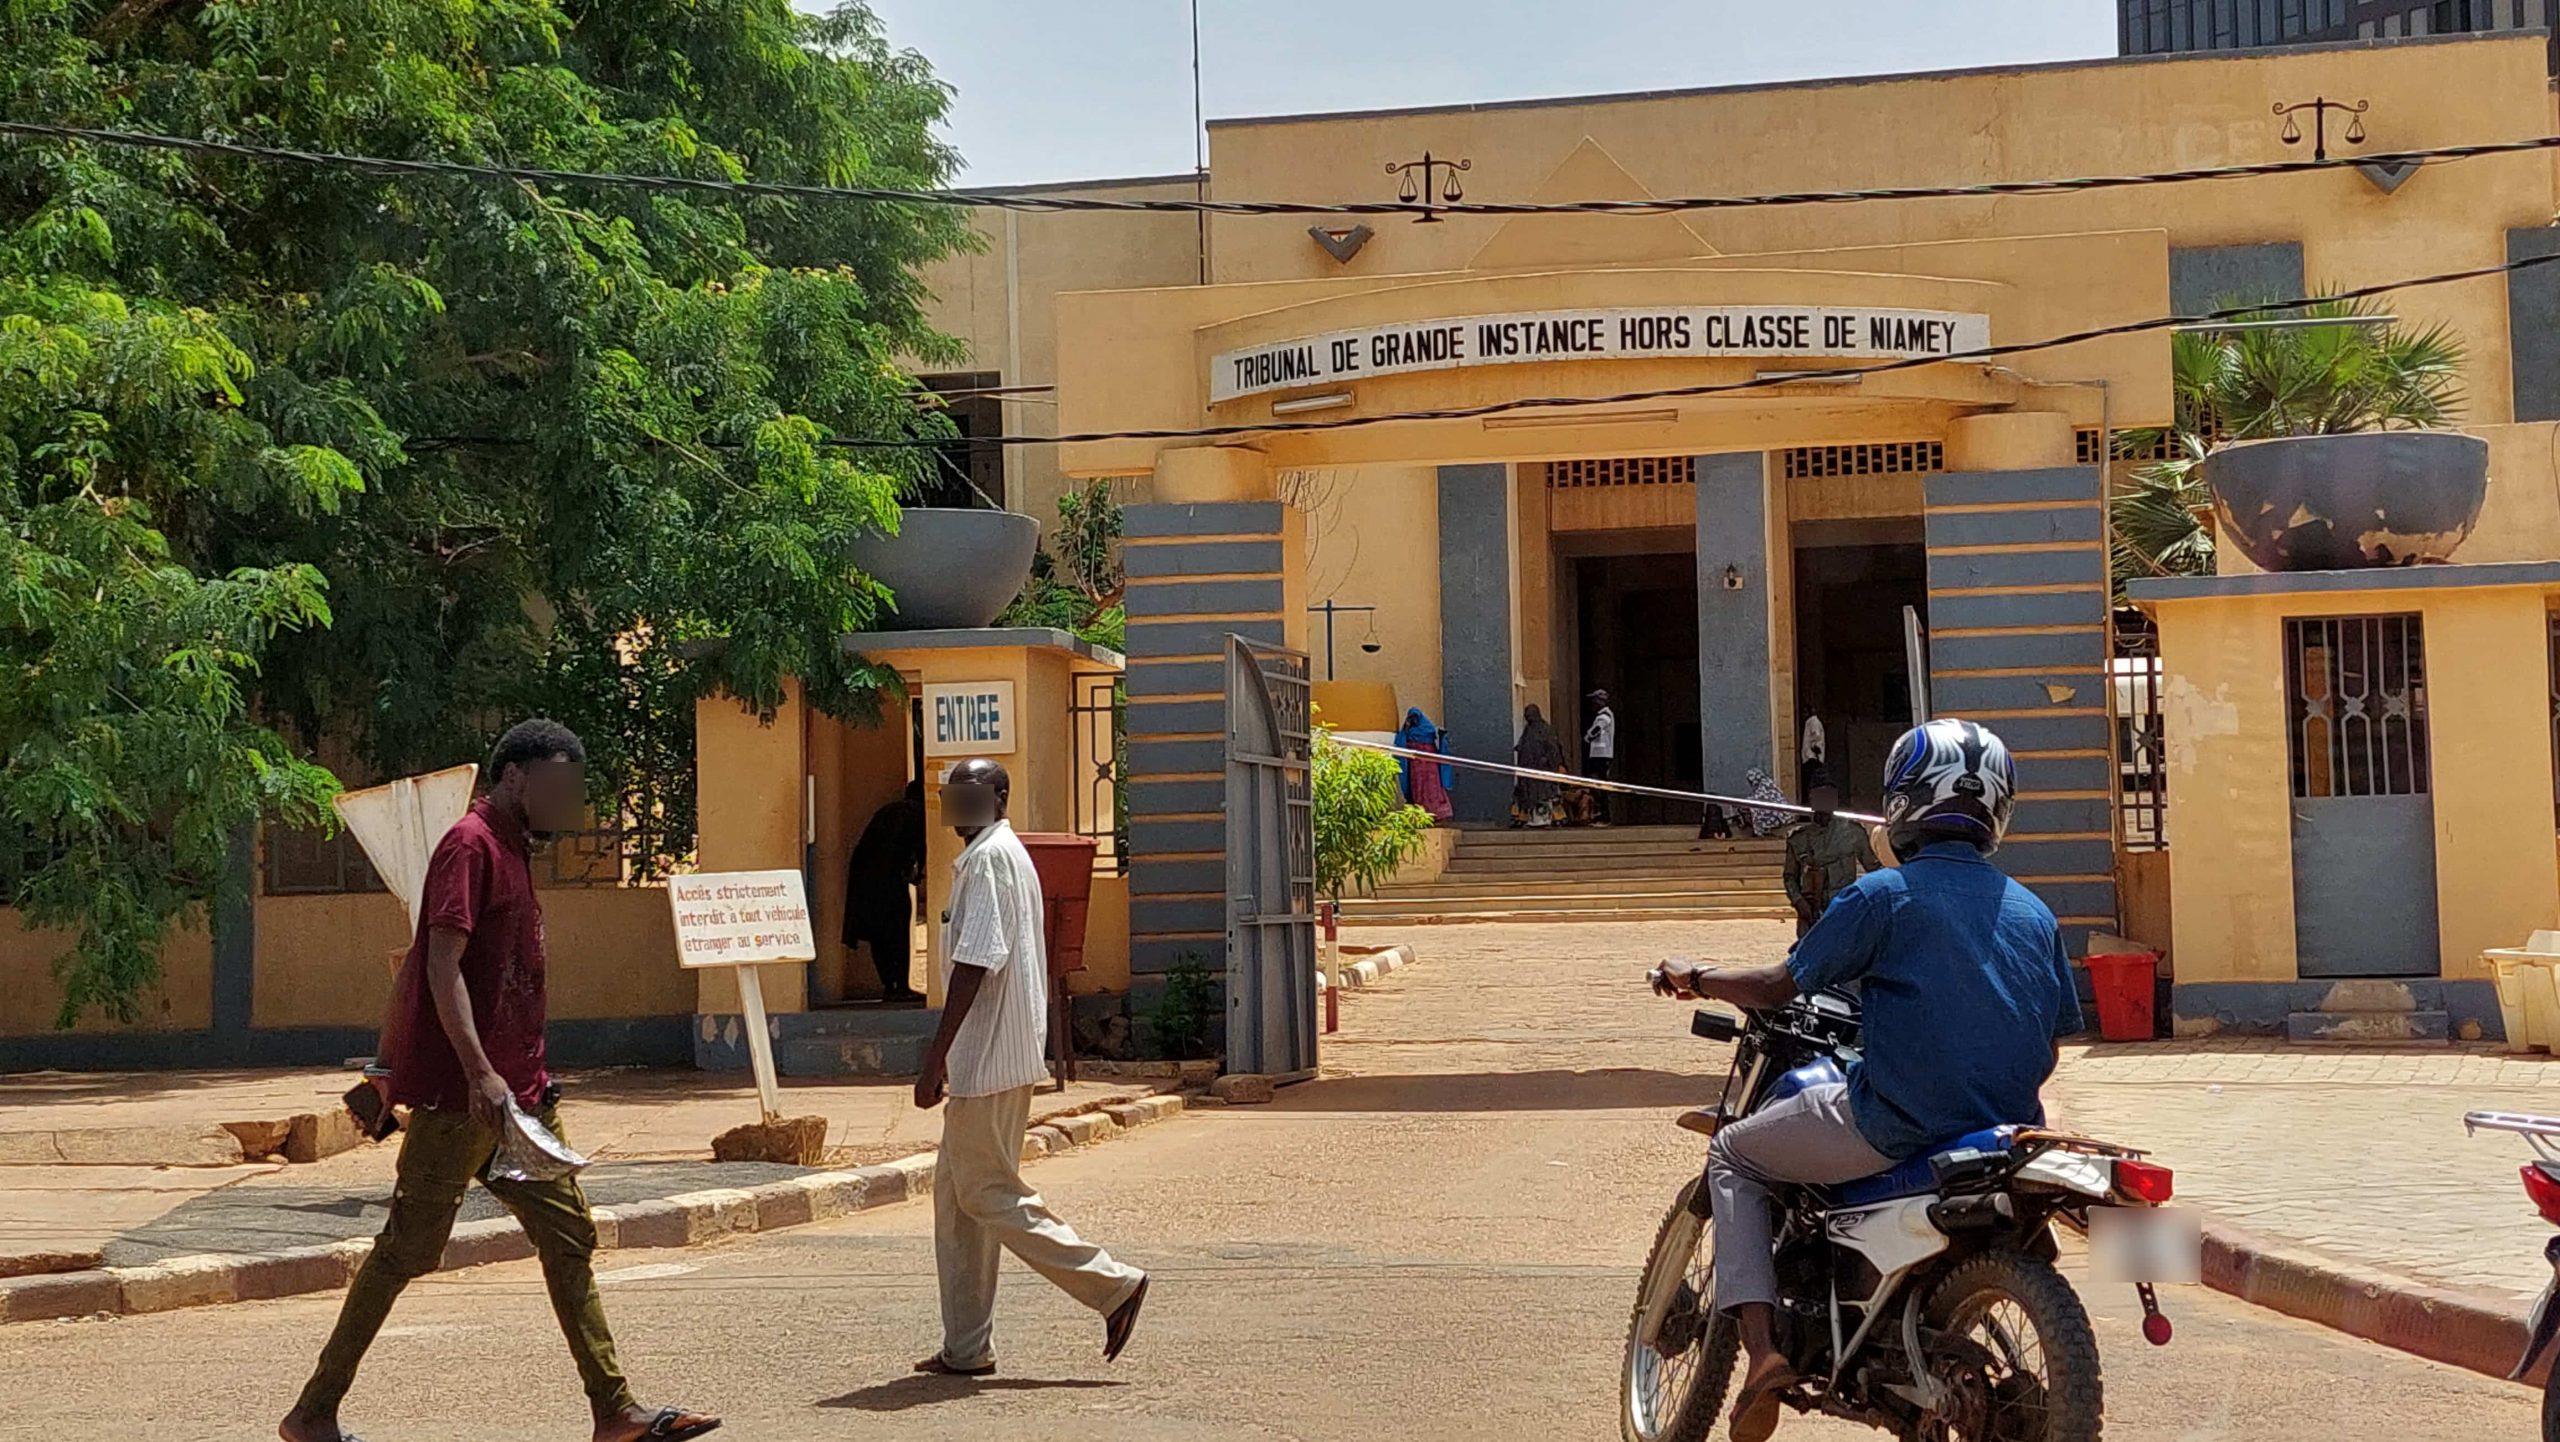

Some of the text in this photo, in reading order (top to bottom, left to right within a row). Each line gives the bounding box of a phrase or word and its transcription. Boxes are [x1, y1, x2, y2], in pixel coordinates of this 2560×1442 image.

[1234, 315, 1957, 390] TRIBUNAL DE GRANDE INSTANCE HORS CLASSE DE NIAMEY
[936, 694, 999, 742] ENTREE
[716, 881, 788, 900] strictement
[679, 909, 727, 927] interdit
[740, 909, 762, 924] tout
[766, 904, 807, 922] véhicule
[684, 930, 800, 954] étranger au service
